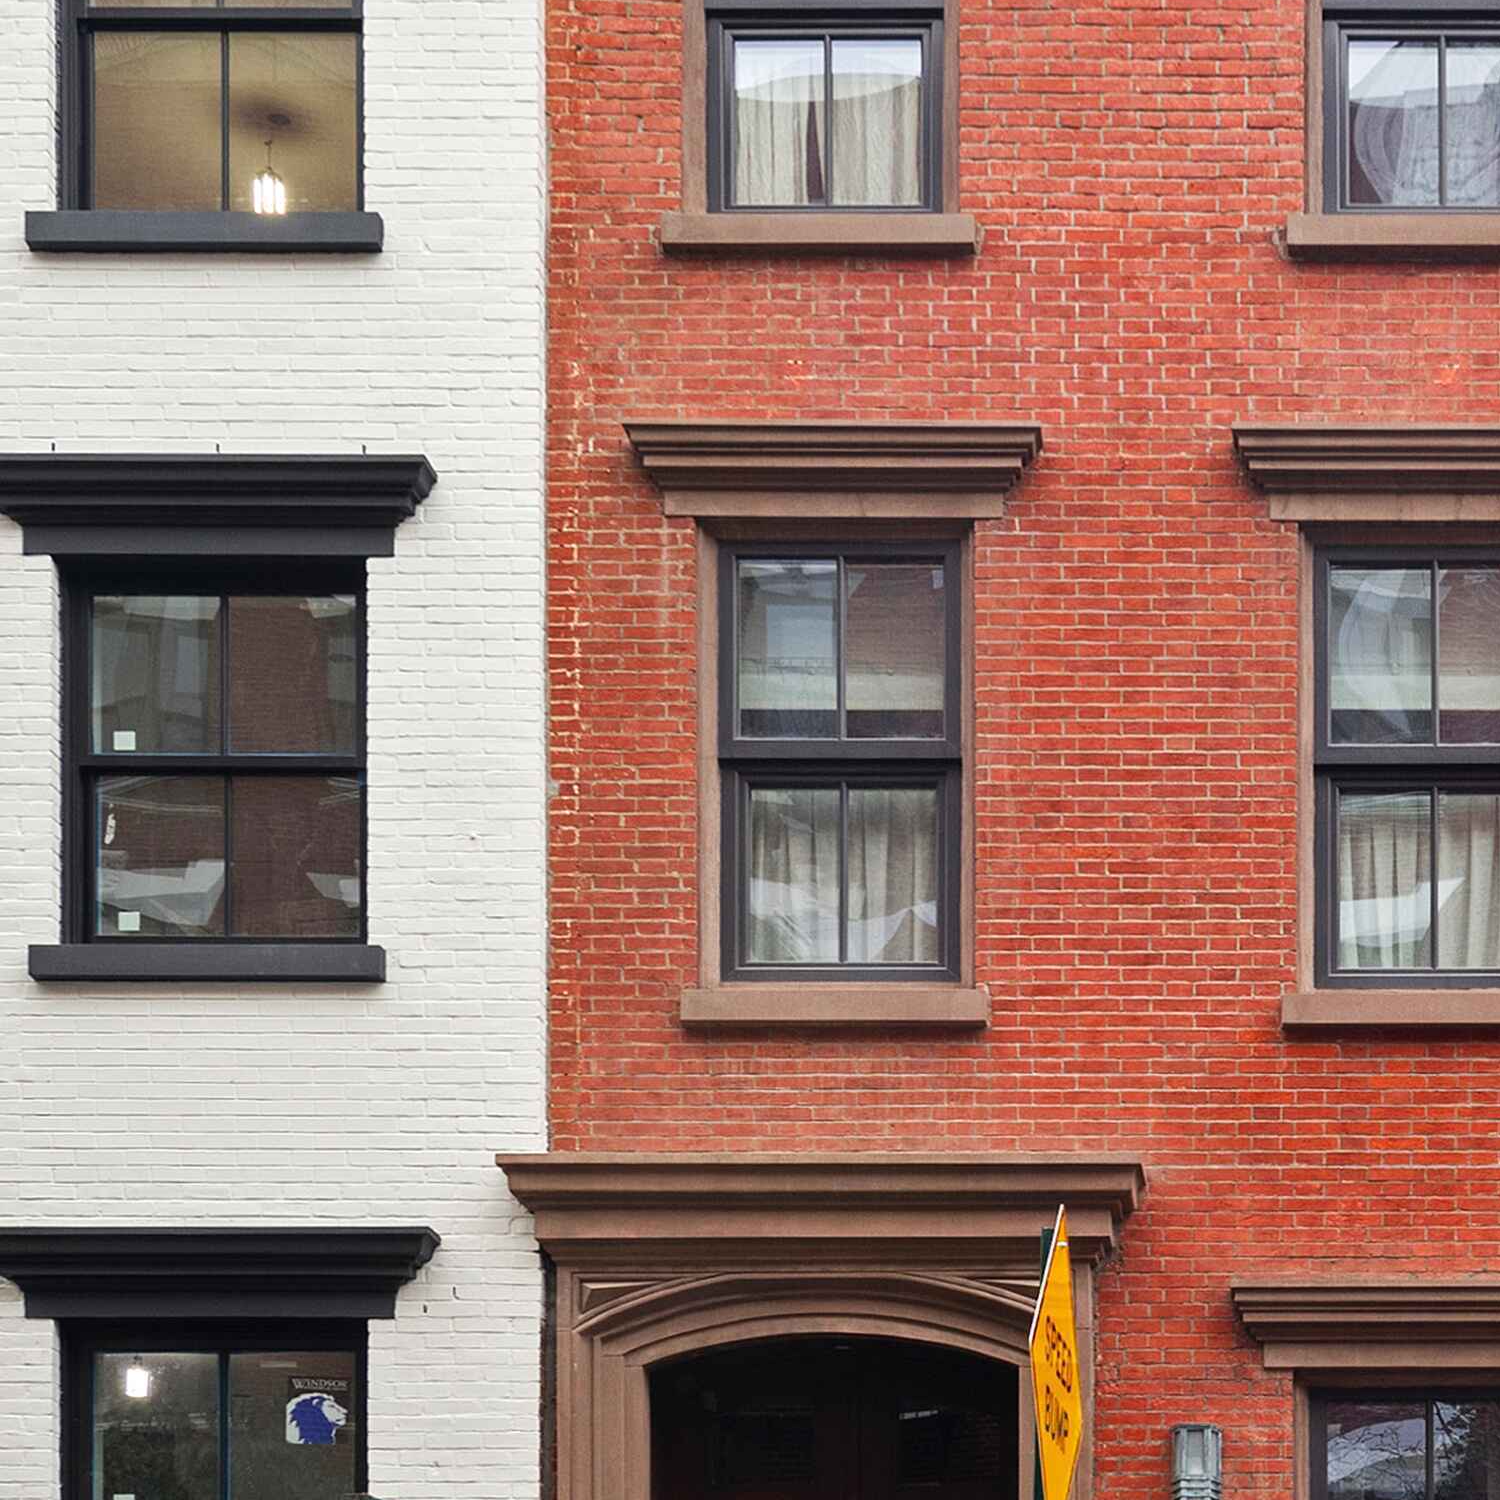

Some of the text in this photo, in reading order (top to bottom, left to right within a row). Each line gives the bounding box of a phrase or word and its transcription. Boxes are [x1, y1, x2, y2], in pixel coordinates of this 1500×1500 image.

[291, 1378, 348, 1389] WINDSOR
[1046, 1316, 1072, 1393] SPEED
[1045, 1385, 1069, 1454] BUMP
